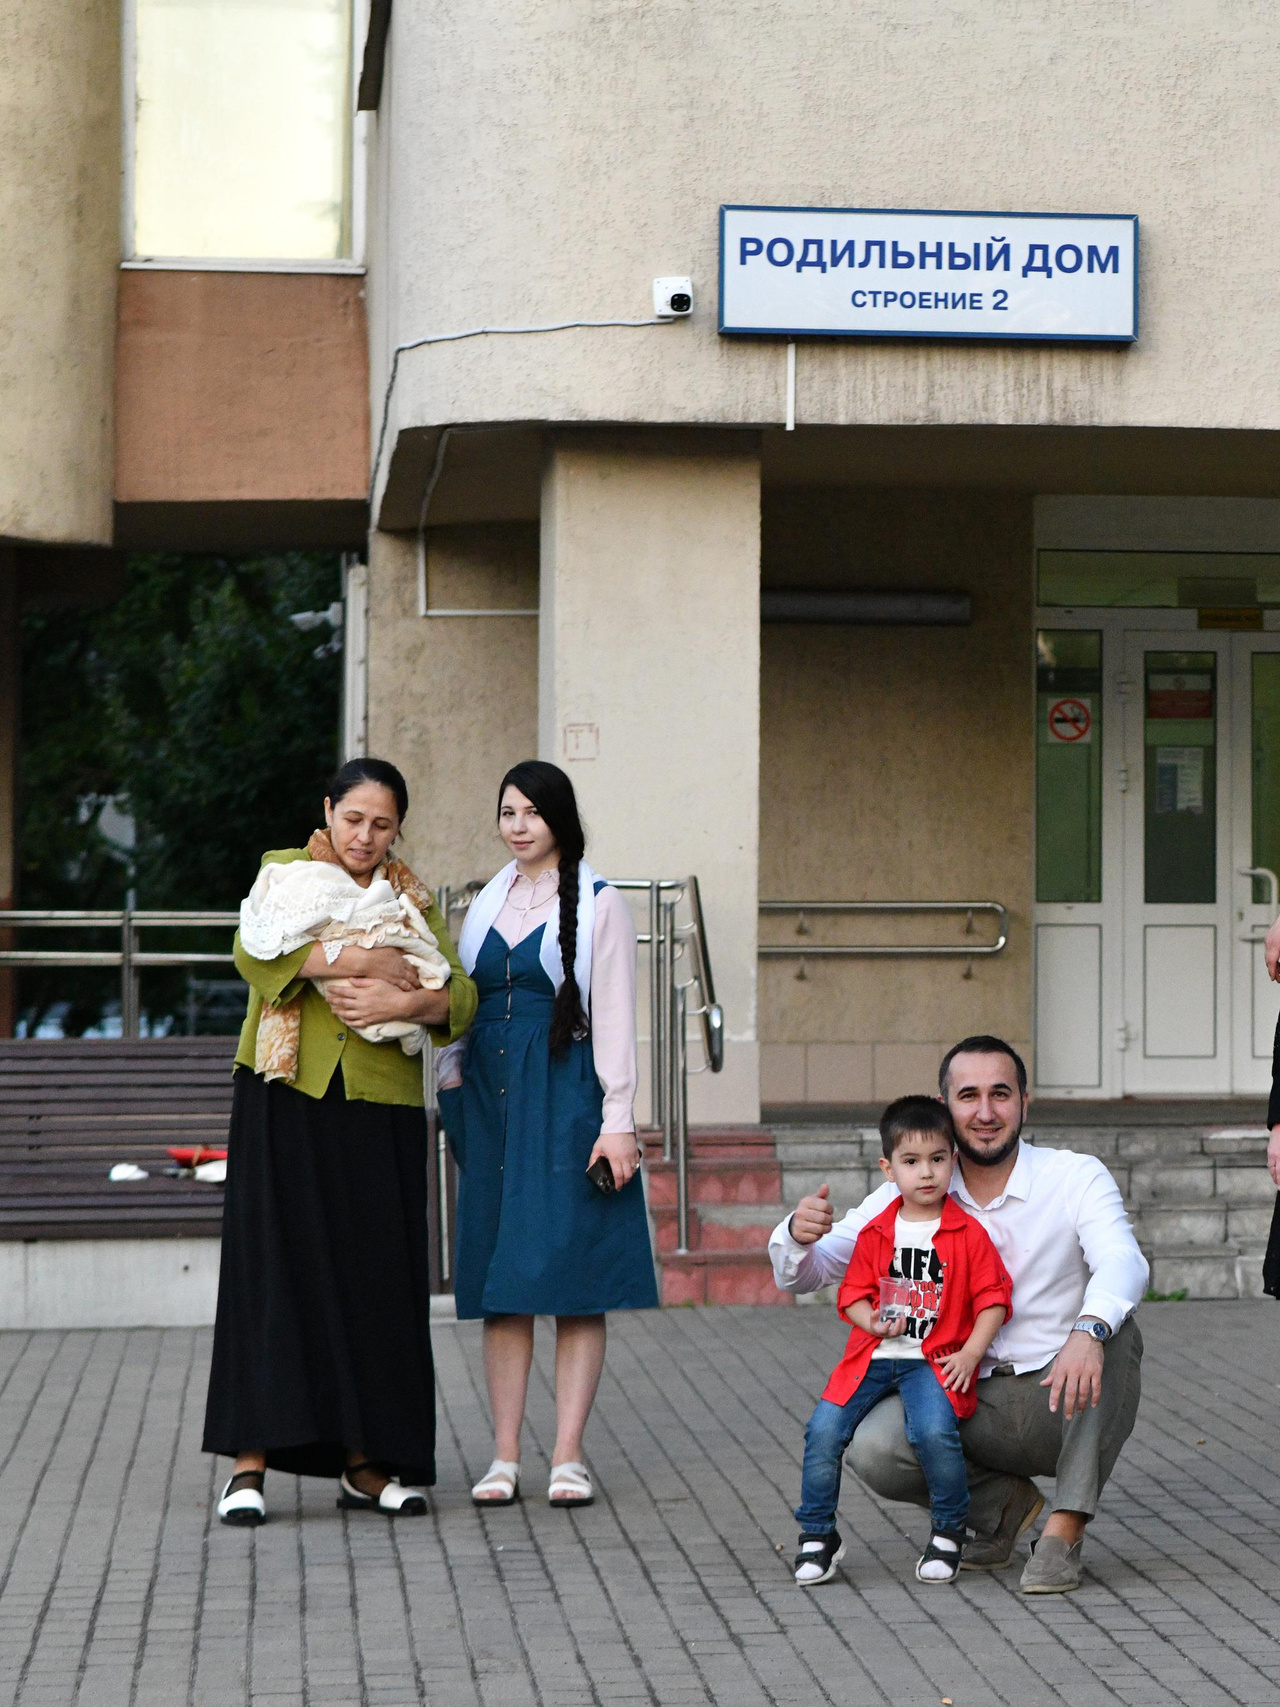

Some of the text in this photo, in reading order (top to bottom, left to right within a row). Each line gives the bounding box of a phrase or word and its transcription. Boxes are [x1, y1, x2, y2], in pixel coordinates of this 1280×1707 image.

[739, 236, 1120, 279] РОДИЛЬНЫЙ ДОМ
[850, 288, 1009, 311] СТРОЕНИЕ 2
[888, 1247, 943, 1283] LIFE
